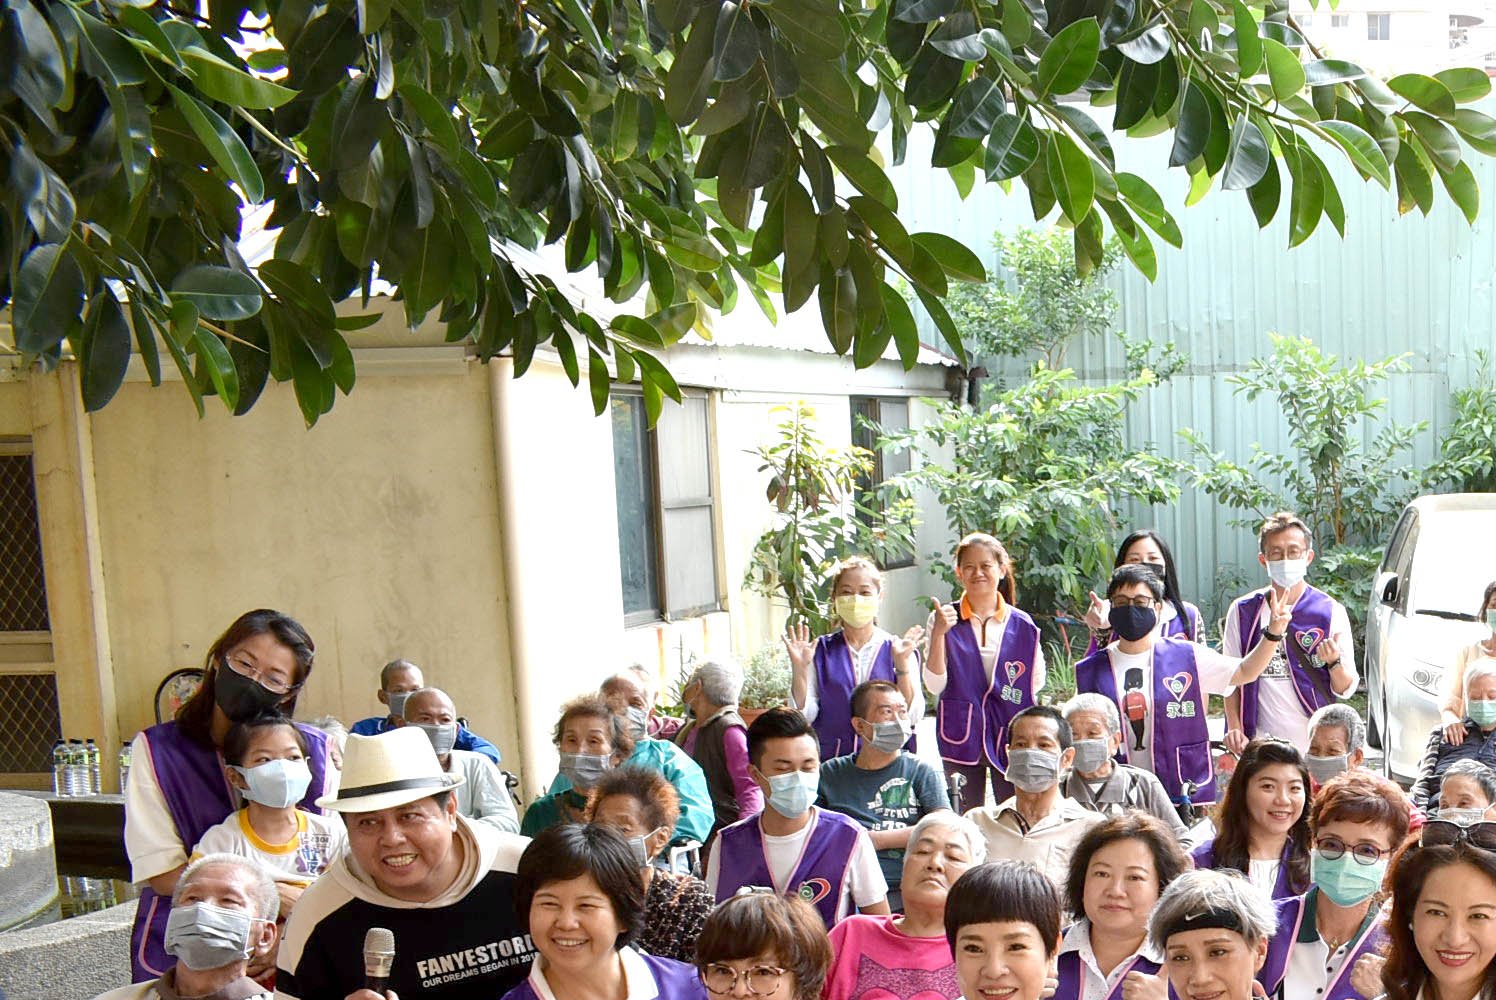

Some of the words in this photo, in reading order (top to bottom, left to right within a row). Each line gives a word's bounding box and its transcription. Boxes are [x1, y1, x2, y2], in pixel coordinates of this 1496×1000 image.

[1166, 700, 1196, 719] 永達
[422, 976, 442, 988] OUR
[442, 967, 480, 984] DREAMS
[480, 959, 510, 974] BEGAN
[520, 952, 537, 964] 201
